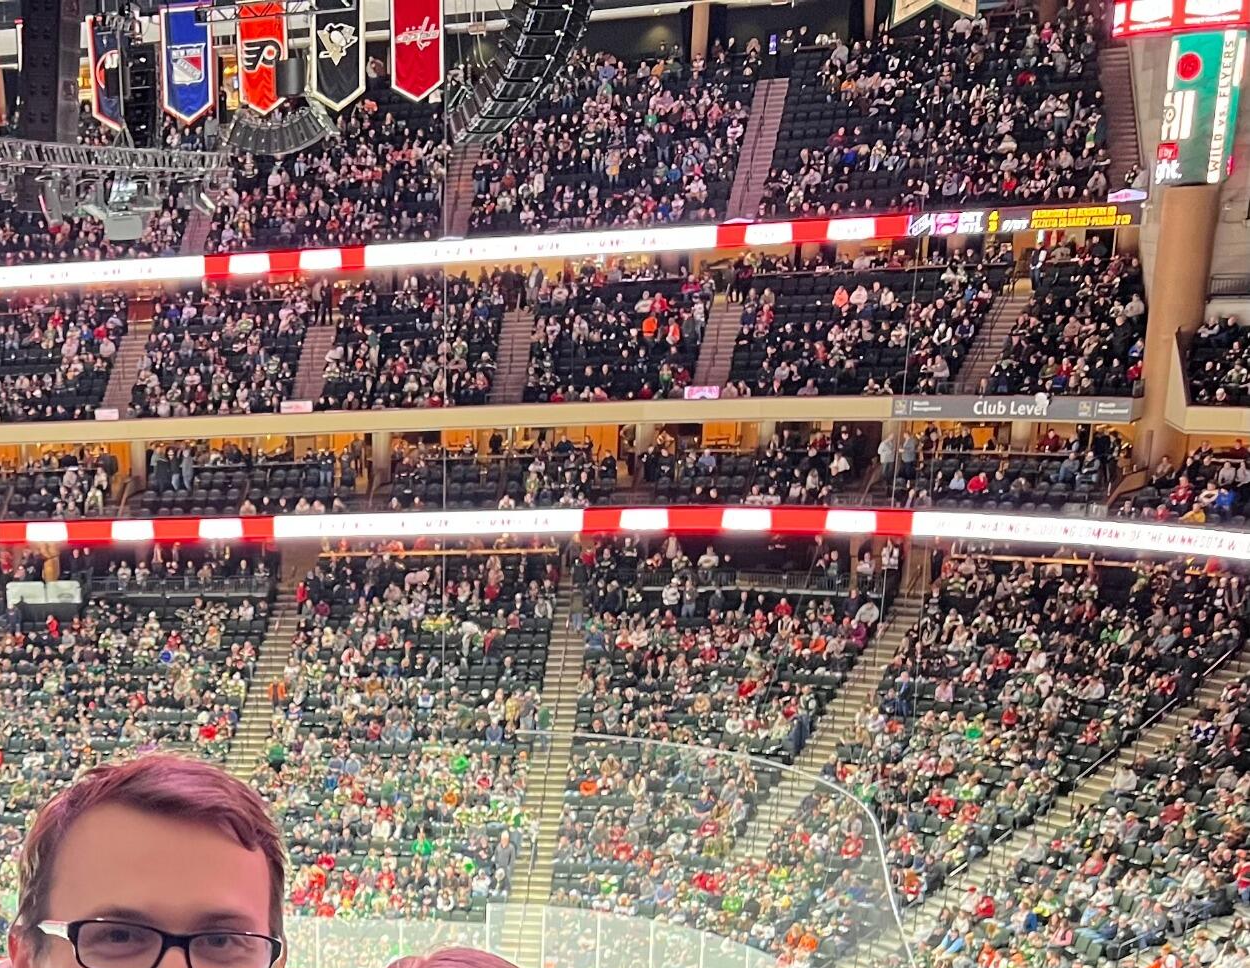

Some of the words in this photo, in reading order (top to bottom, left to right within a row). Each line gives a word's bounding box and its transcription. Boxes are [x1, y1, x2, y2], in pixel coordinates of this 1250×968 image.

[1209, 133, 1224, 172] WILD
[1219, 40, 1235, 98] FLYERS
[972, 400, 1008, 416] Club
[1009, 400, 1049, 417] Level
